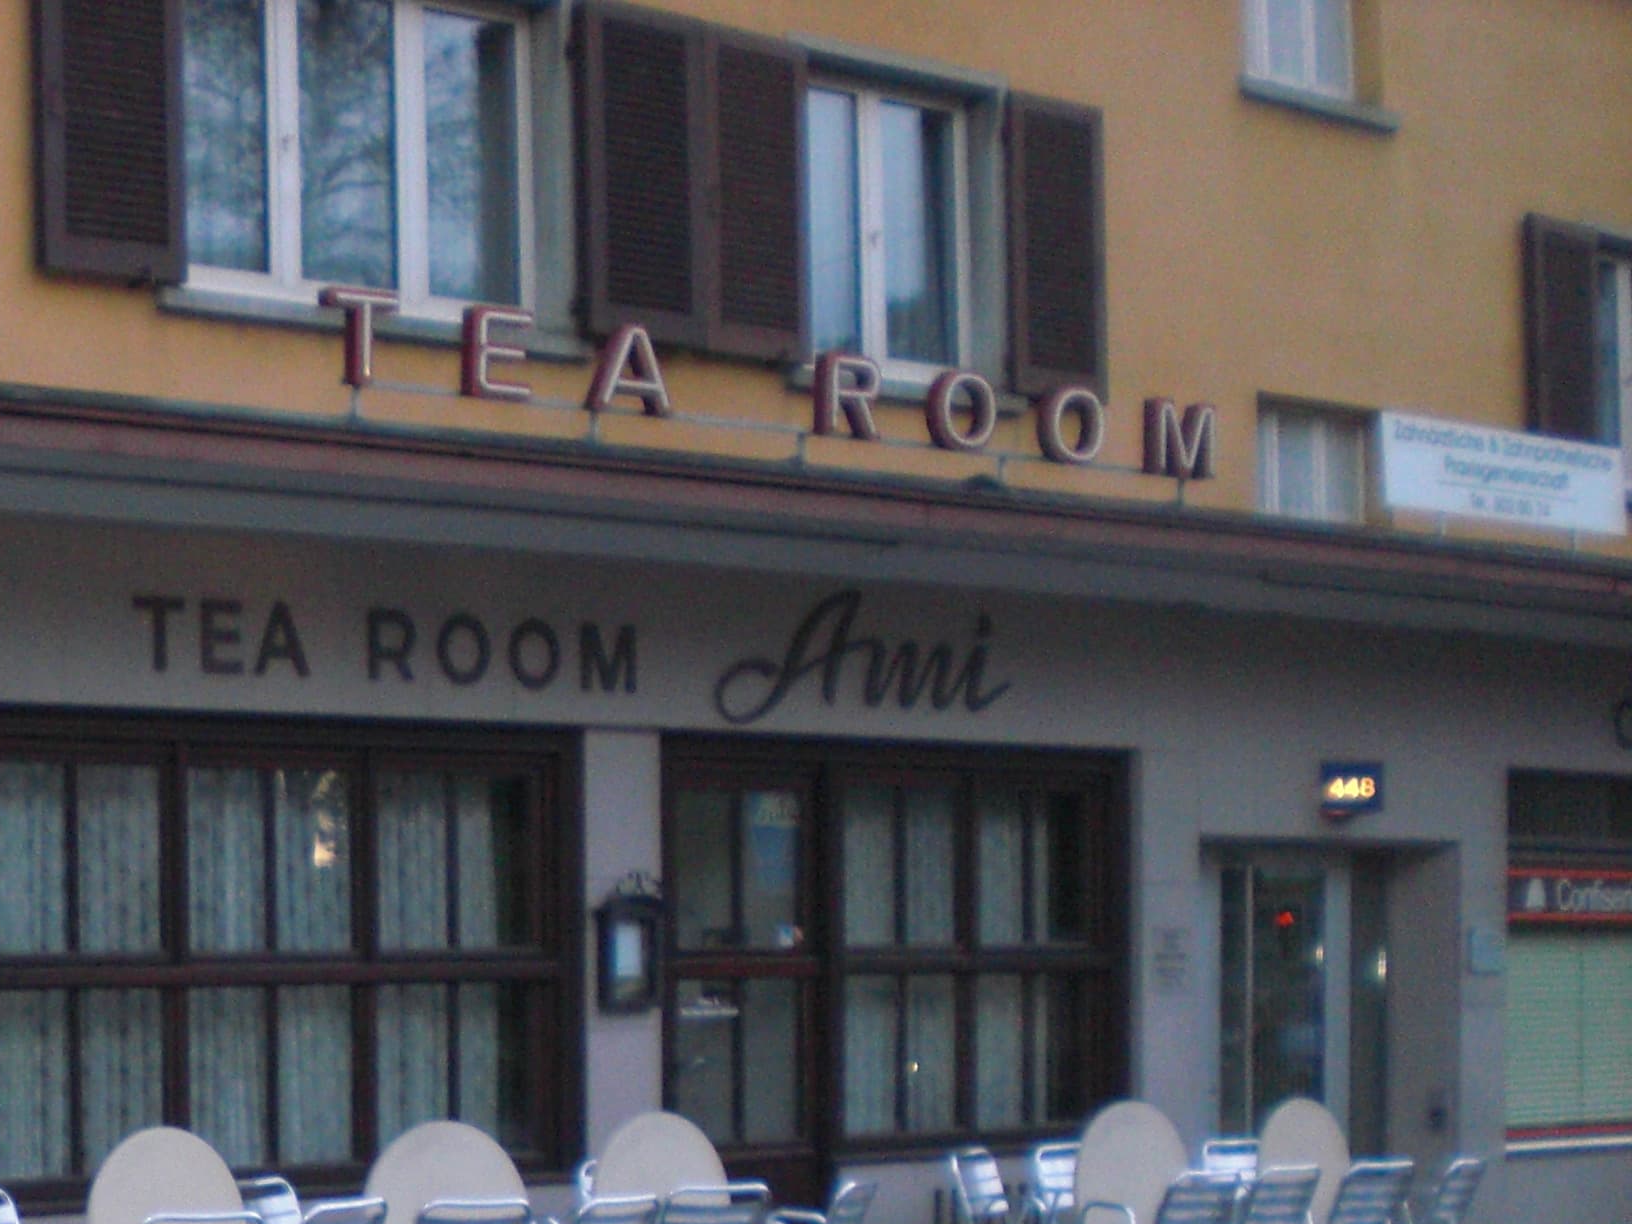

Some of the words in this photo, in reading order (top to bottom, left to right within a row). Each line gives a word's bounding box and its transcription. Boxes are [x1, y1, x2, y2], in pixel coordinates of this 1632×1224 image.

[318, 286, 671, 418] TEA
[812, 349, 1217, 481] ROOM
[132, 596, 310, 678] TEA
[366, 606, 638, 694] ROOM
[714, 588, 1010, 725] Ami
[1325, 776, 1376, 799] 448
